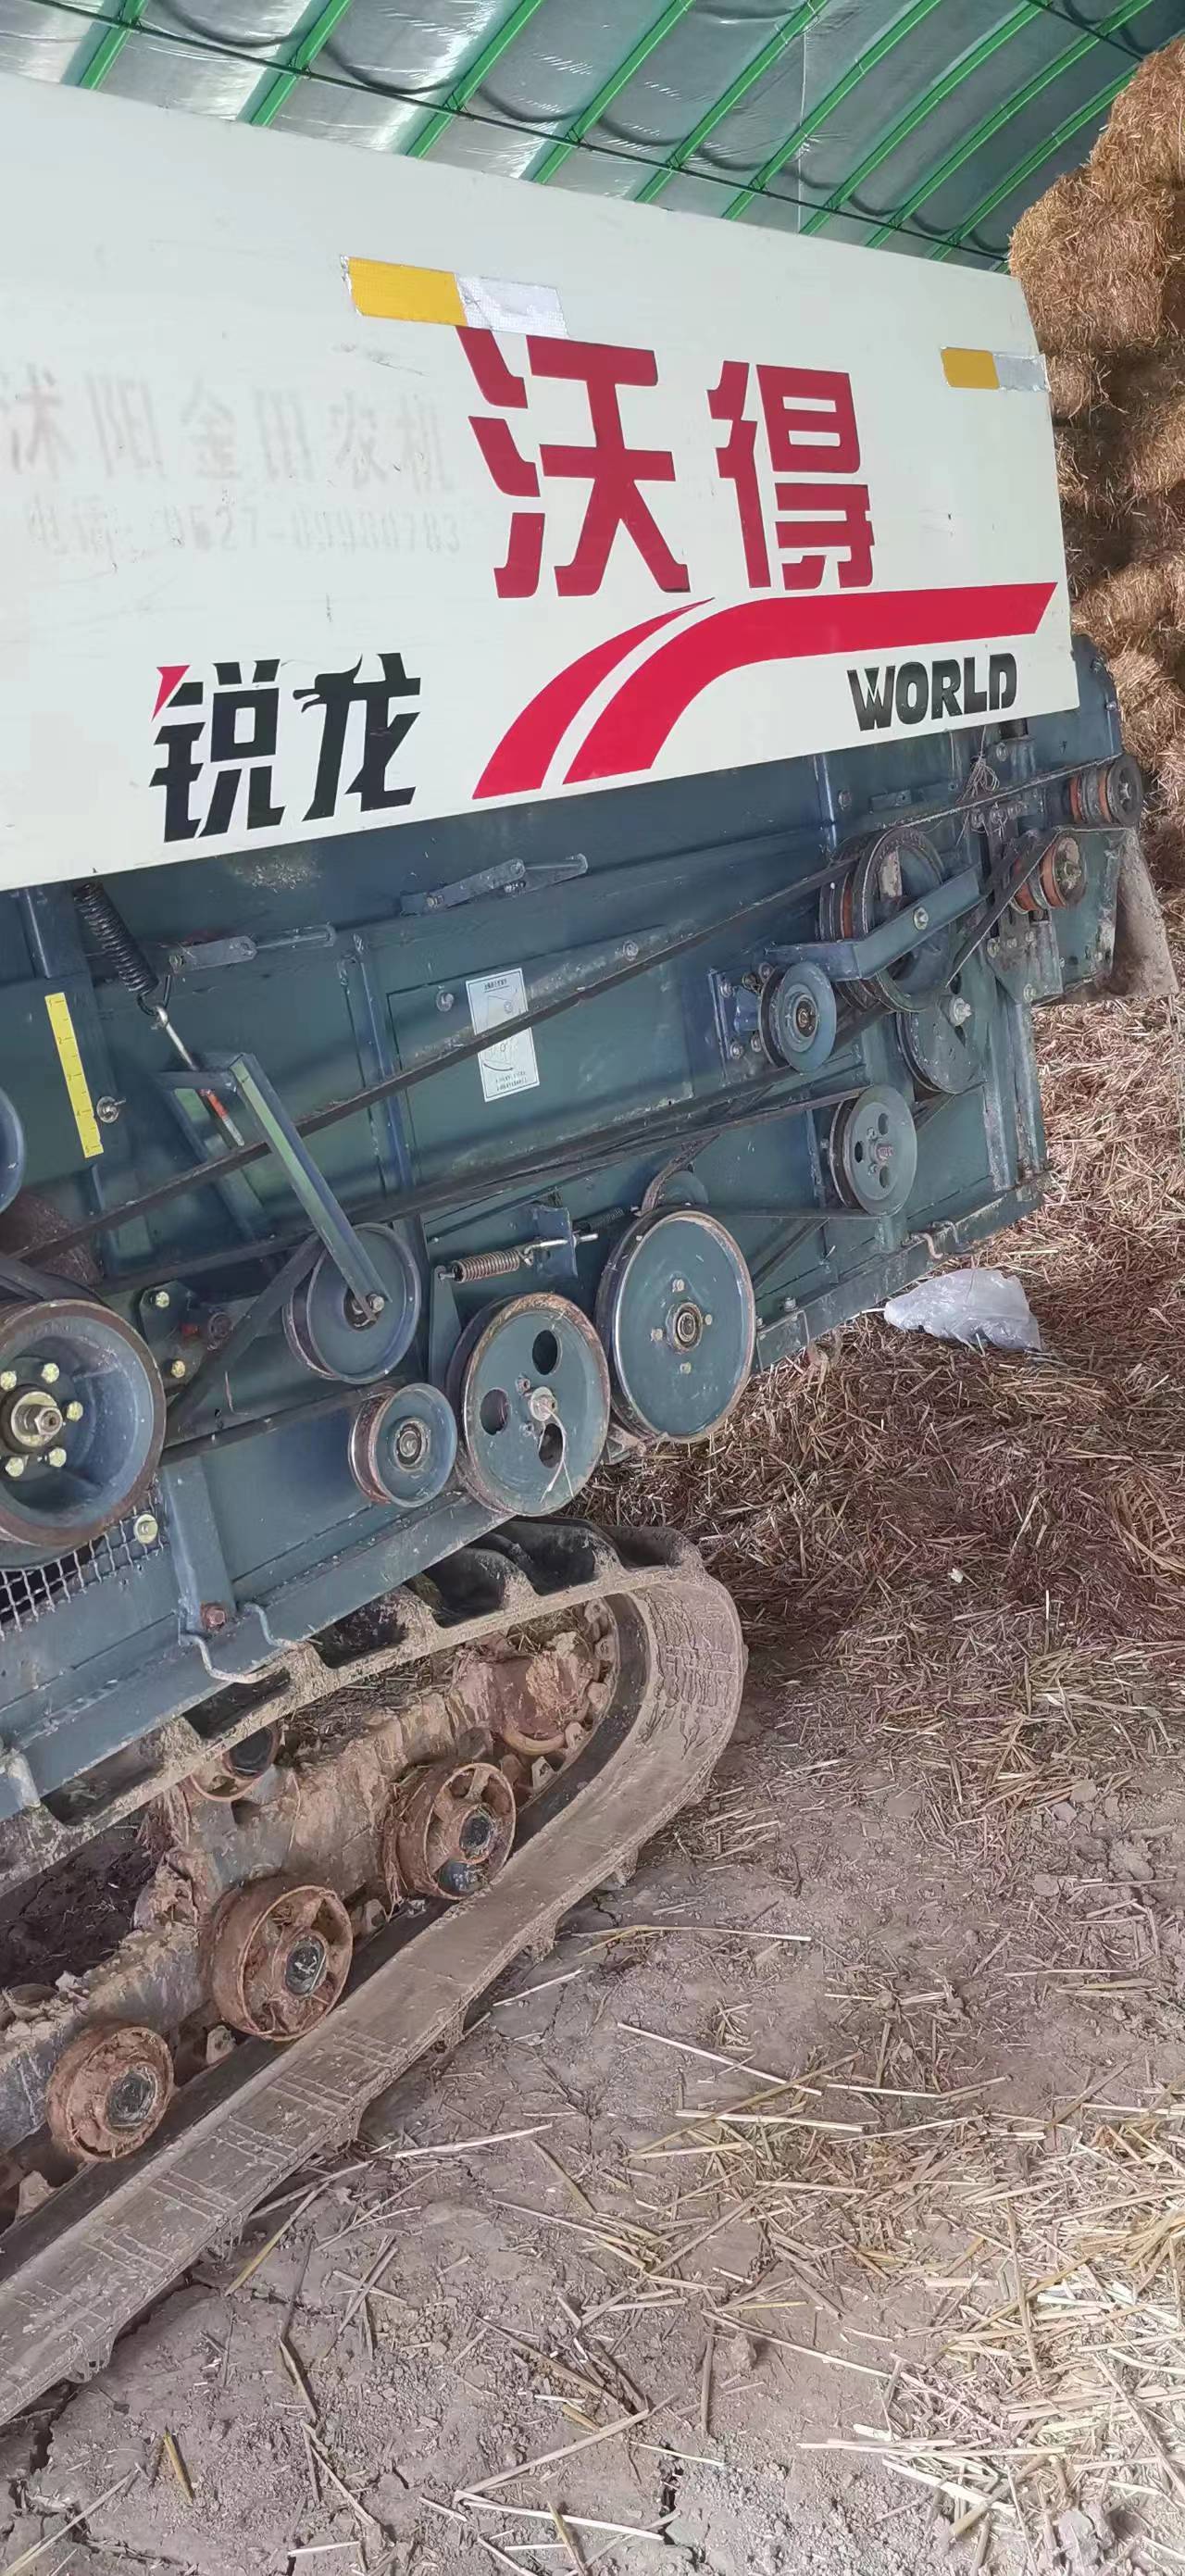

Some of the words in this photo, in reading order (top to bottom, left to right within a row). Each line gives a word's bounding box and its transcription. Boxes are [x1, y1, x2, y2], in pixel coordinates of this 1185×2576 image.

[455, 325, 875, 598] 沃得
[148, 652, 421, 844] 锐龙
[846, 652, 1017, 732] WORLD
